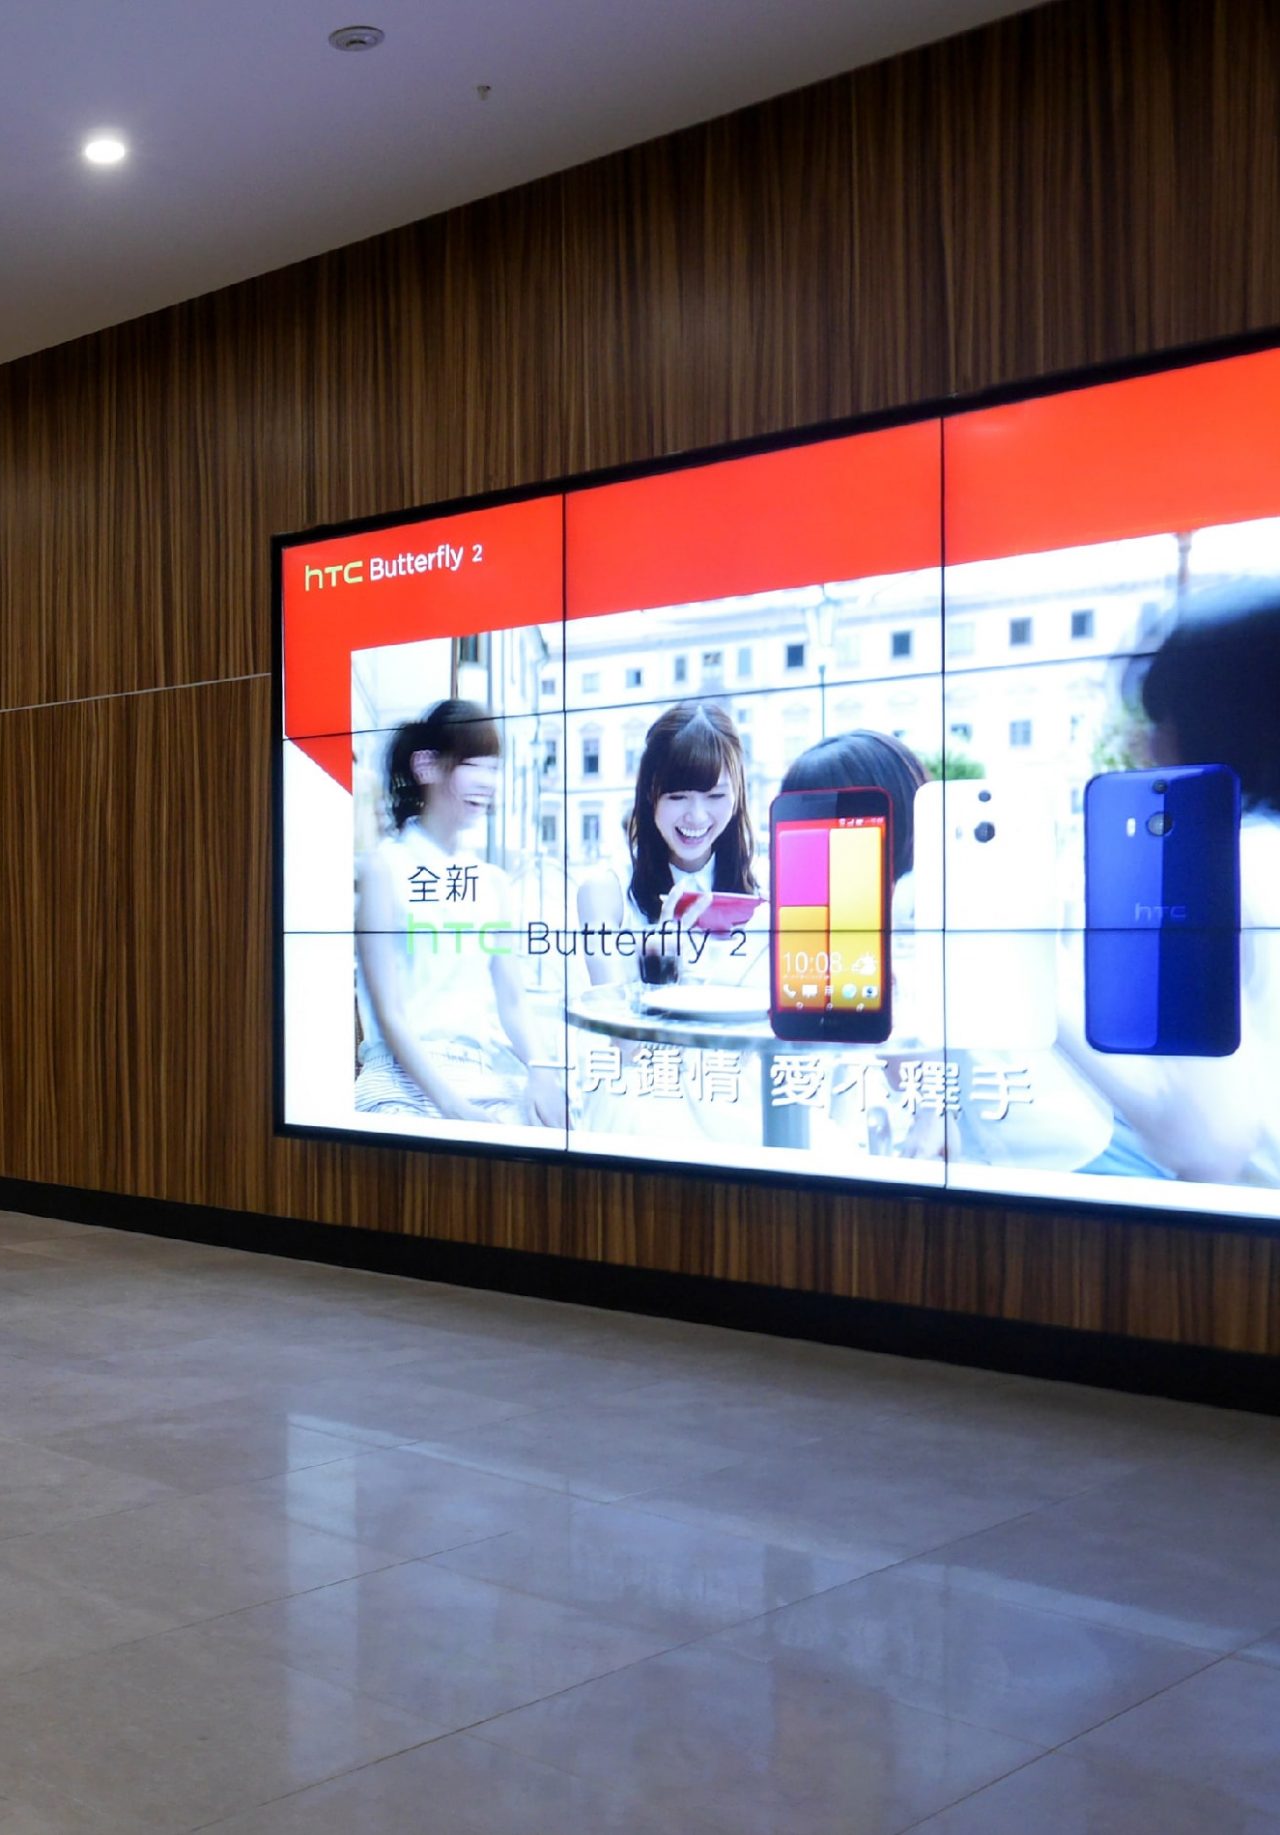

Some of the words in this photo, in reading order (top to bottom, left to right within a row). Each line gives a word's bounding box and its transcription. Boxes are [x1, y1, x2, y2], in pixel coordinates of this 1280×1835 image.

[369, 543, 464, 582] Butterfly
[471, 544, 483, 563] 2
[408, 864, 479, 902] 全新
[527, 920, 711, 964] Butterfly
[729, 929, 748, 957] 2
[770, 1054, 1034, 1121] 愛不釋手
